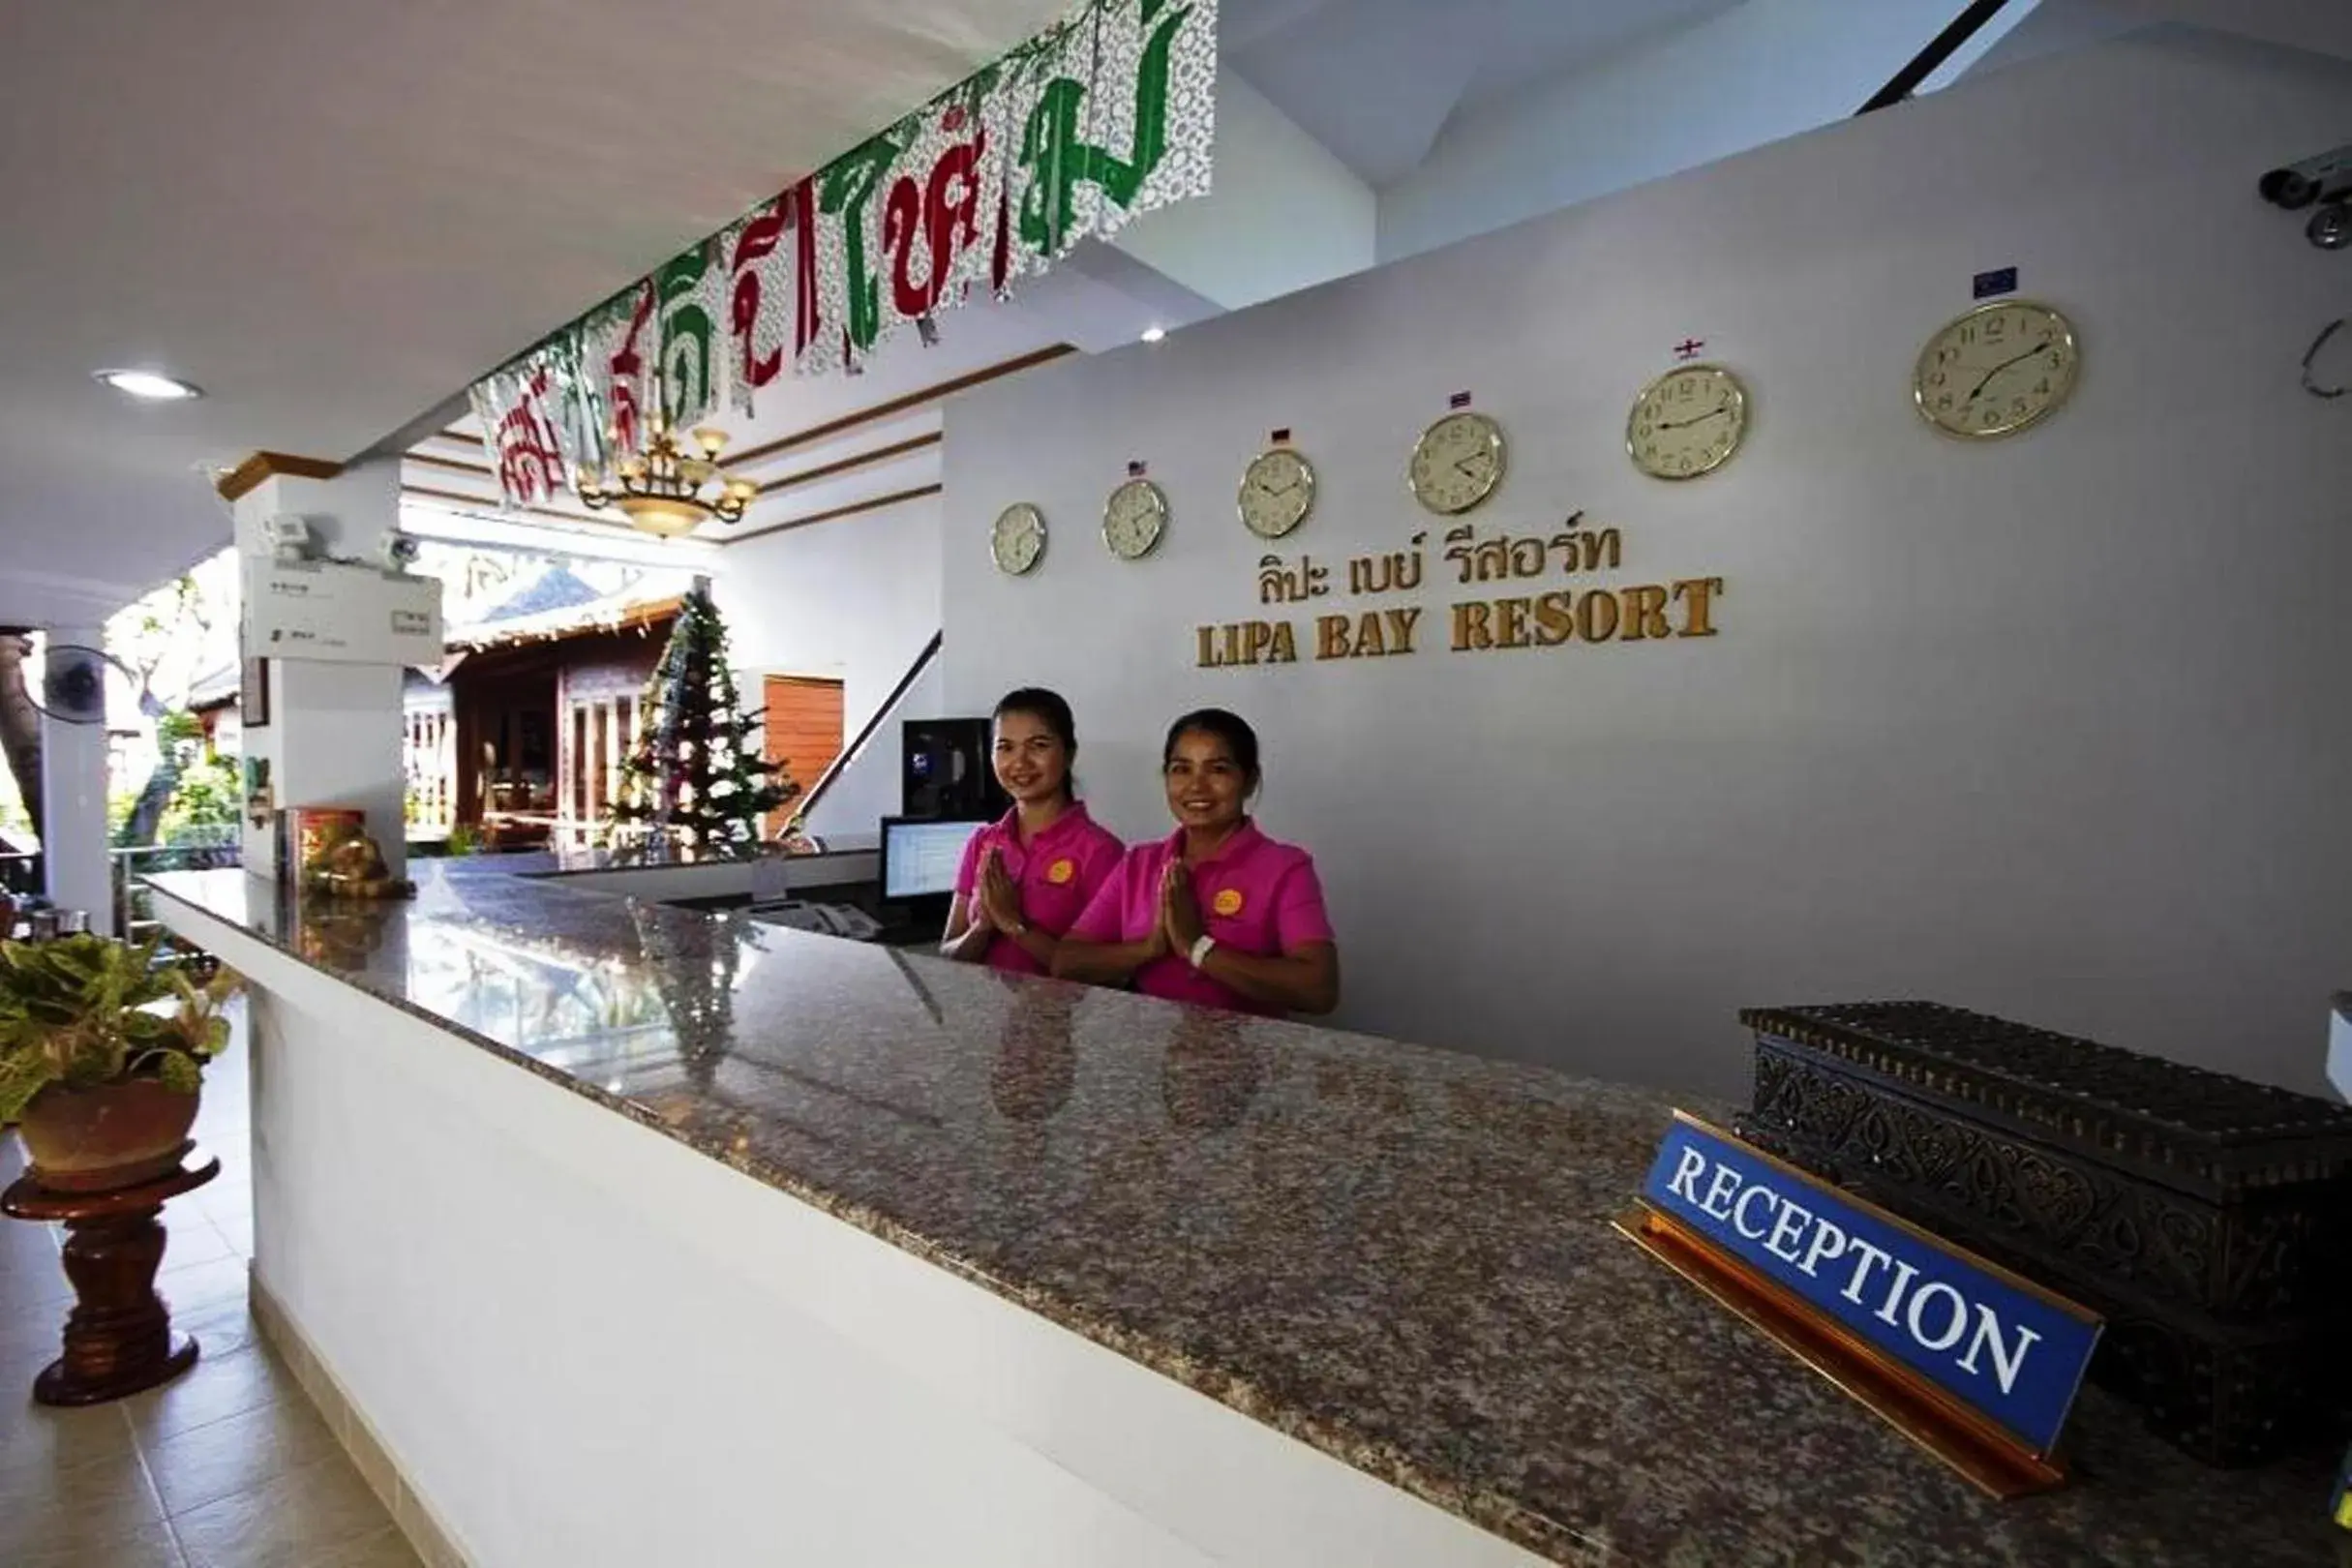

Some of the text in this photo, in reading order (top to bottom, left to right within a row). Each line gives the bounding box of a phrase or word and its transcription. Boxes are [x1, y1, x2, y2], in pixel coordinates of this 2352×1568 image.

[1258, 510, 1621, 604] ลิปะ เบย์ รีสอร์ท
[1196, 577, 1723, 668] LIPA BAY RESORT
[1666, 1145, 2043, 1396] RECEPTION
